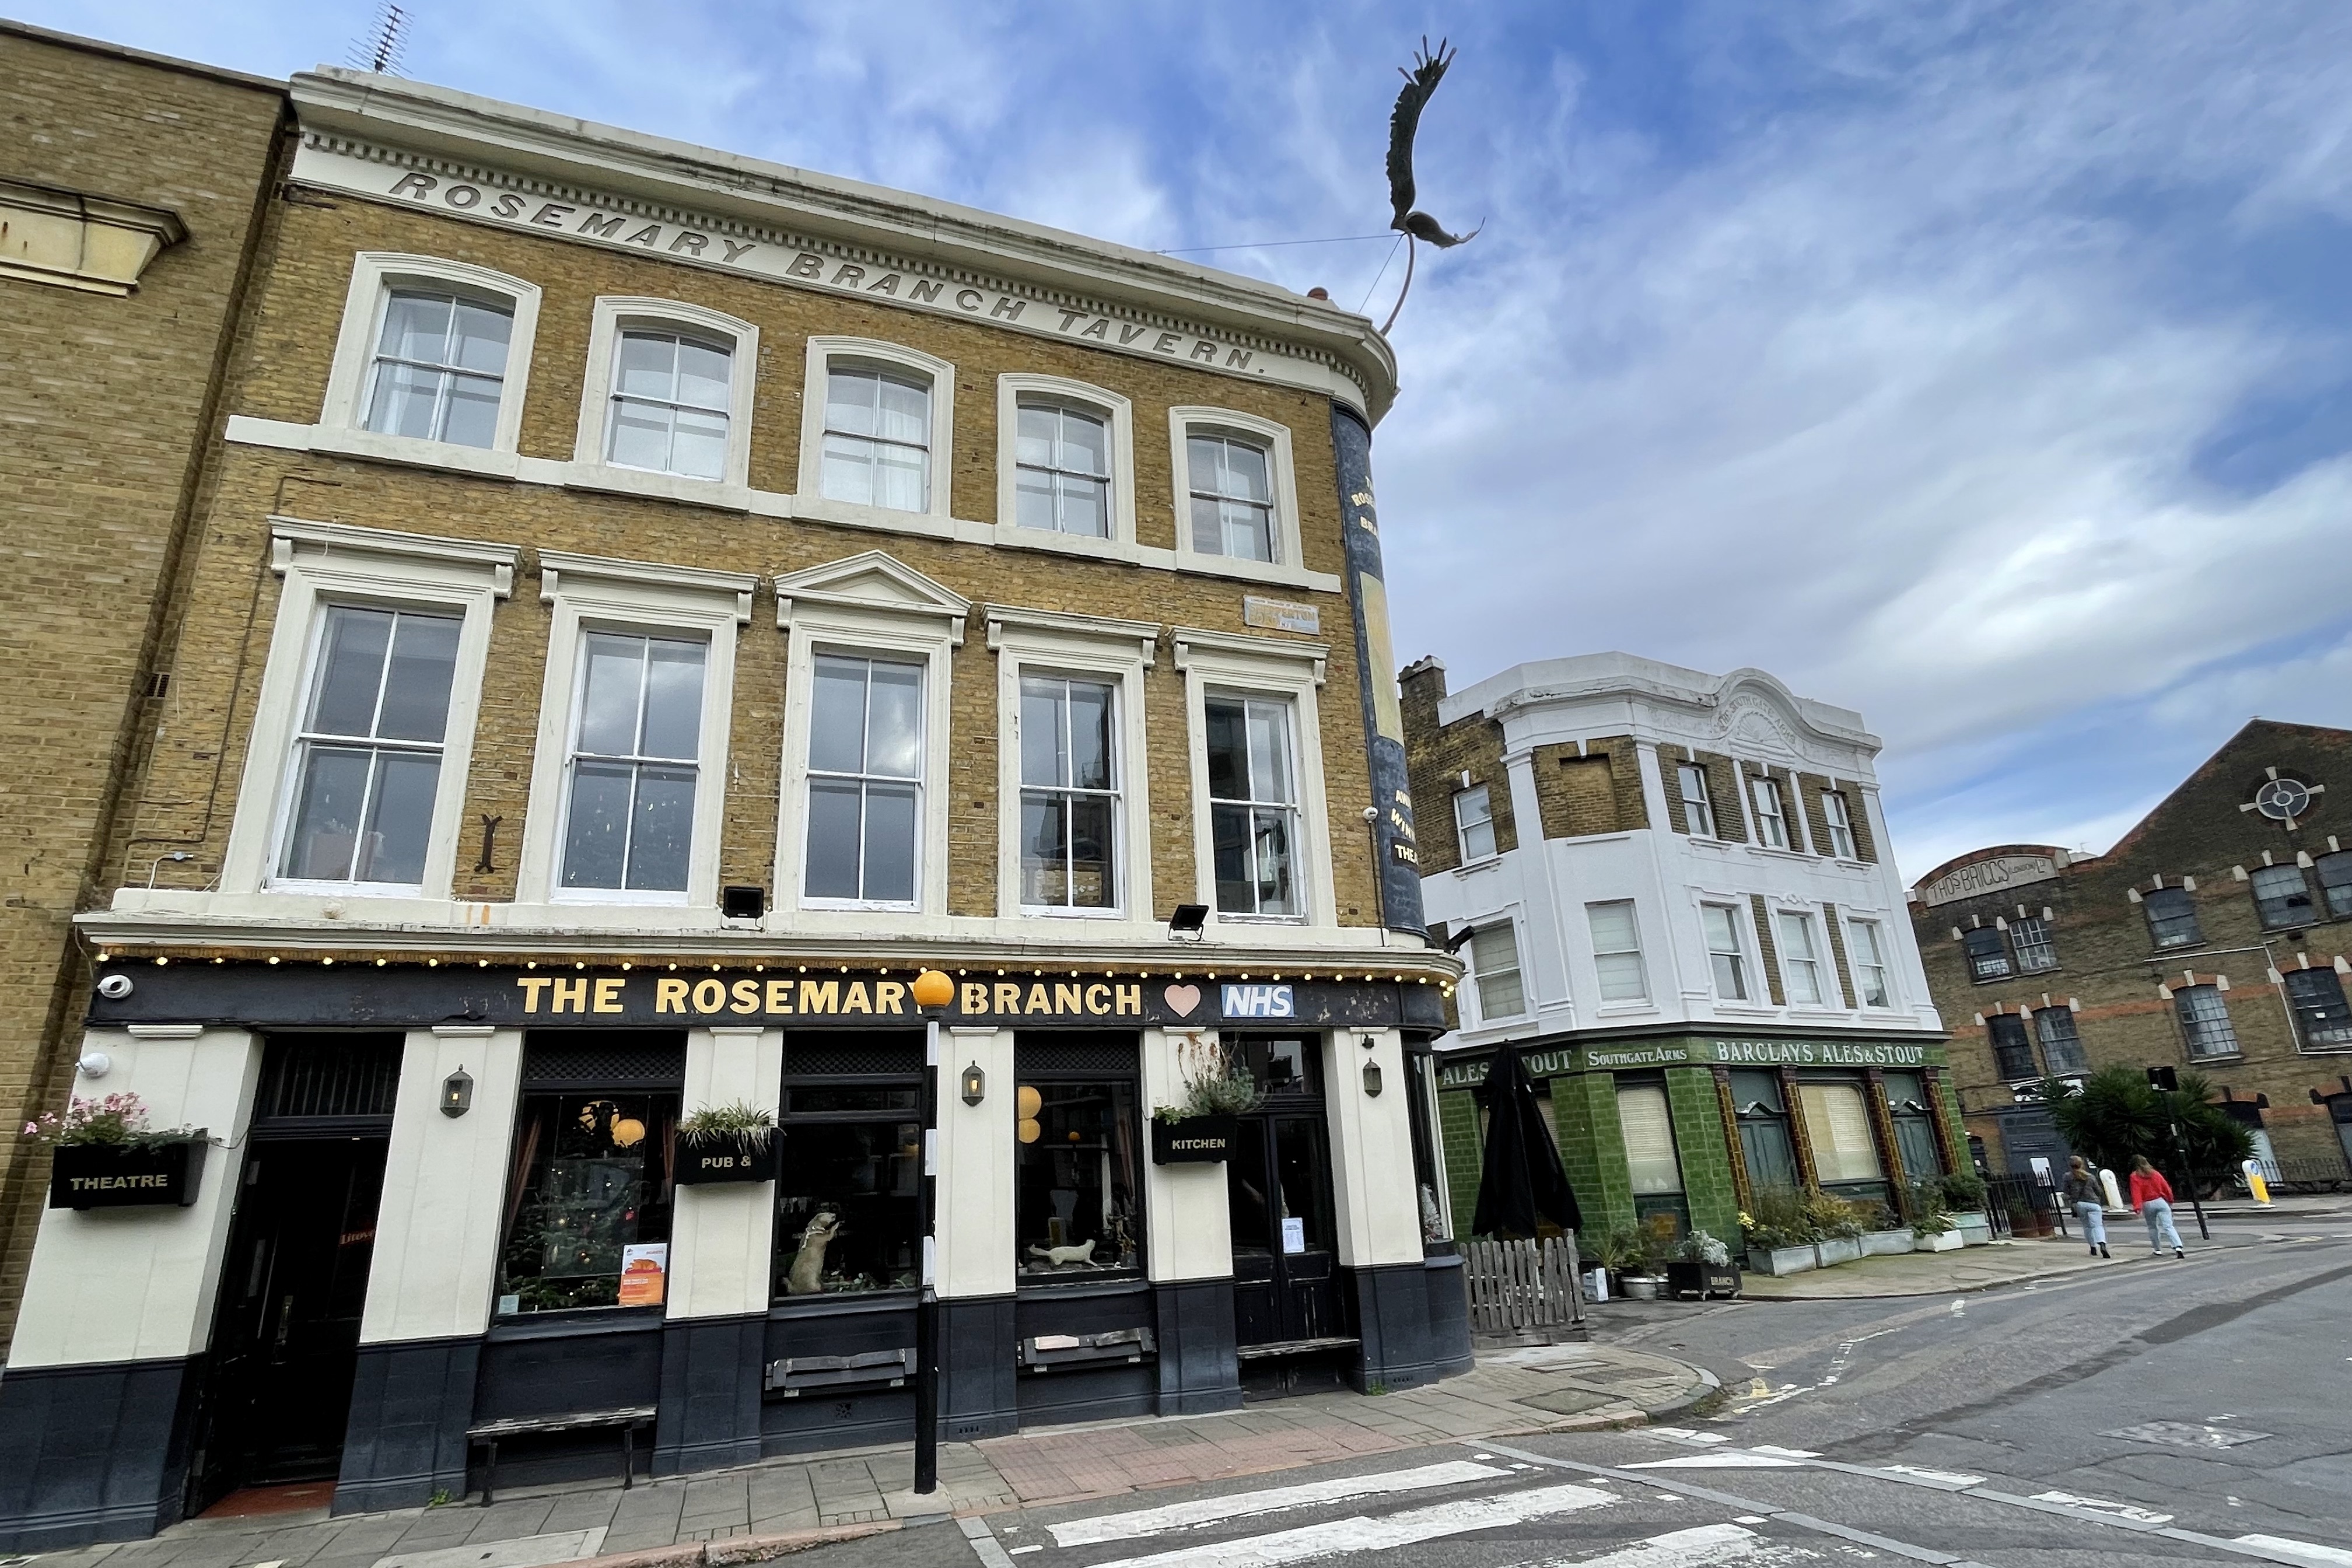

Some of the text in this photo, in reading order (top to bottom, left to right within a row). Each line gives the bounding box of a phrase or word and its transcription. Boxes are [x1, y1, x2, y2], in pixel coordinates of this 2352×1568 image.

[389, 172, 756, 263] ROSEMARY
[785, 253, 1027, 321] BRANCH
[517, 978, 626, 1014] THE
[961, 983, 1142, 1015] BRANCH
[1223, 986, 1292, 1016] NHS
[1716, 1041, 1814, 1063] BARCLAYS
[1172, 1139, 1225, 1150] KITCHEN
[702, 1156, 751, 1168] PUB &
[70, 1174, 168, 1190] THEATRE
